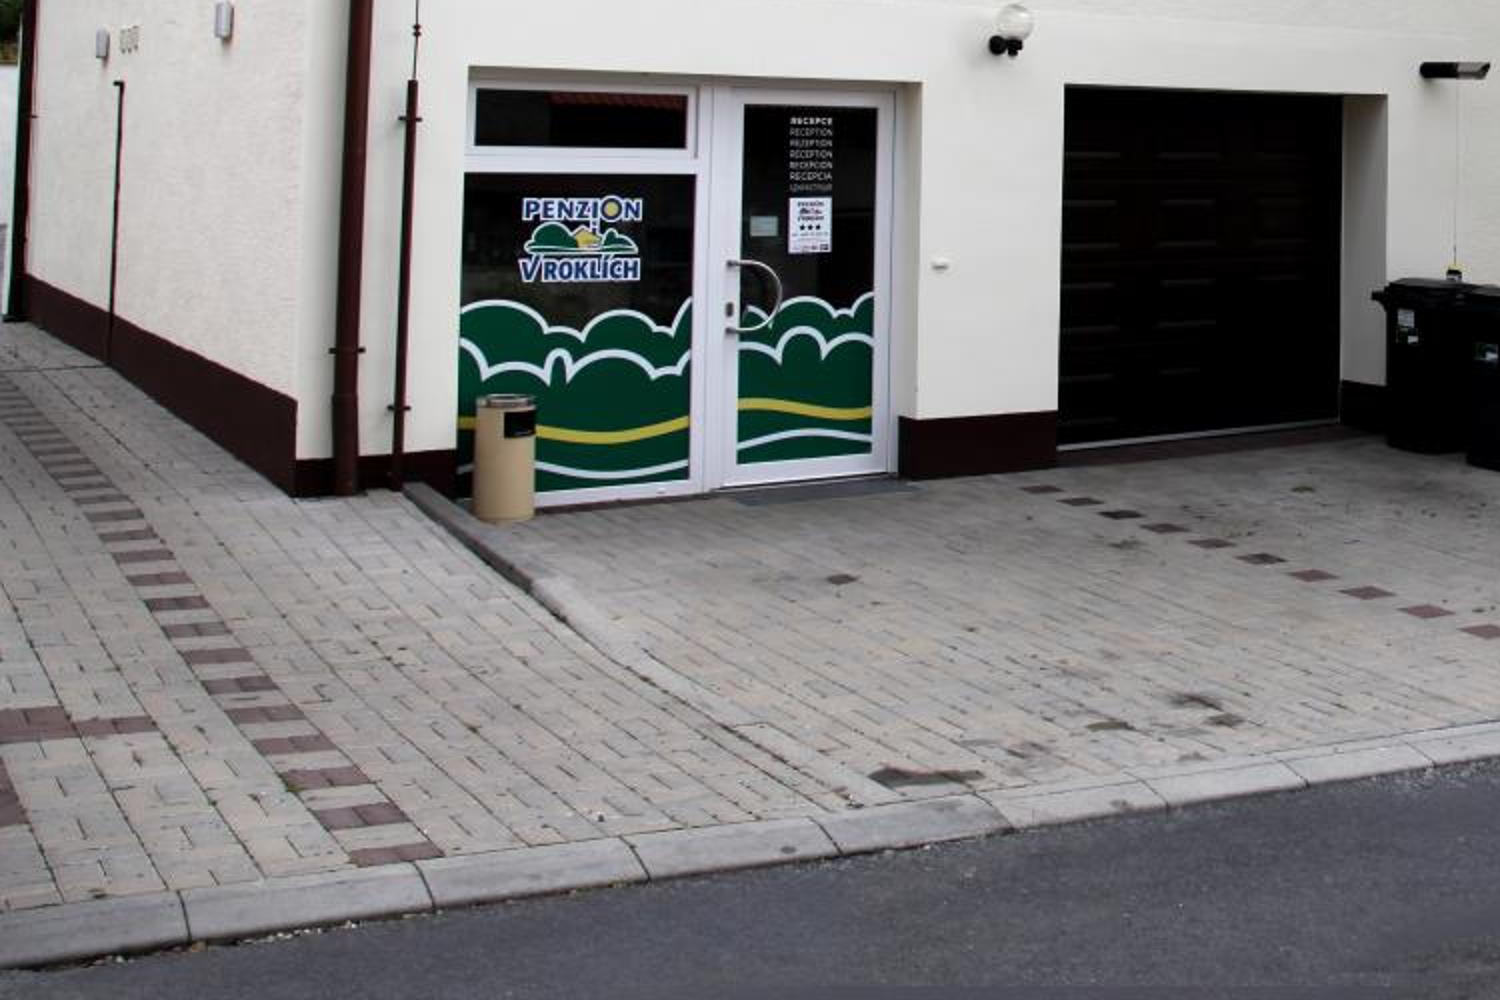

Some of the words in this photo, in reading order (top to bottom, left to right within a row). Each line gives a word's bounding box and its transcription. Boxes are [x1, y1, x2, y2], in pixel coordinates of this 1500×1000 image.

[789, 117, 833, 125] RECEPCE
[789, 127, 833, 136] RECEPTION
[522, 196, 642, 221] PENZION
[519, 255, 542, 281] V
[543, 256, 640, 281] ROKLÍCH
